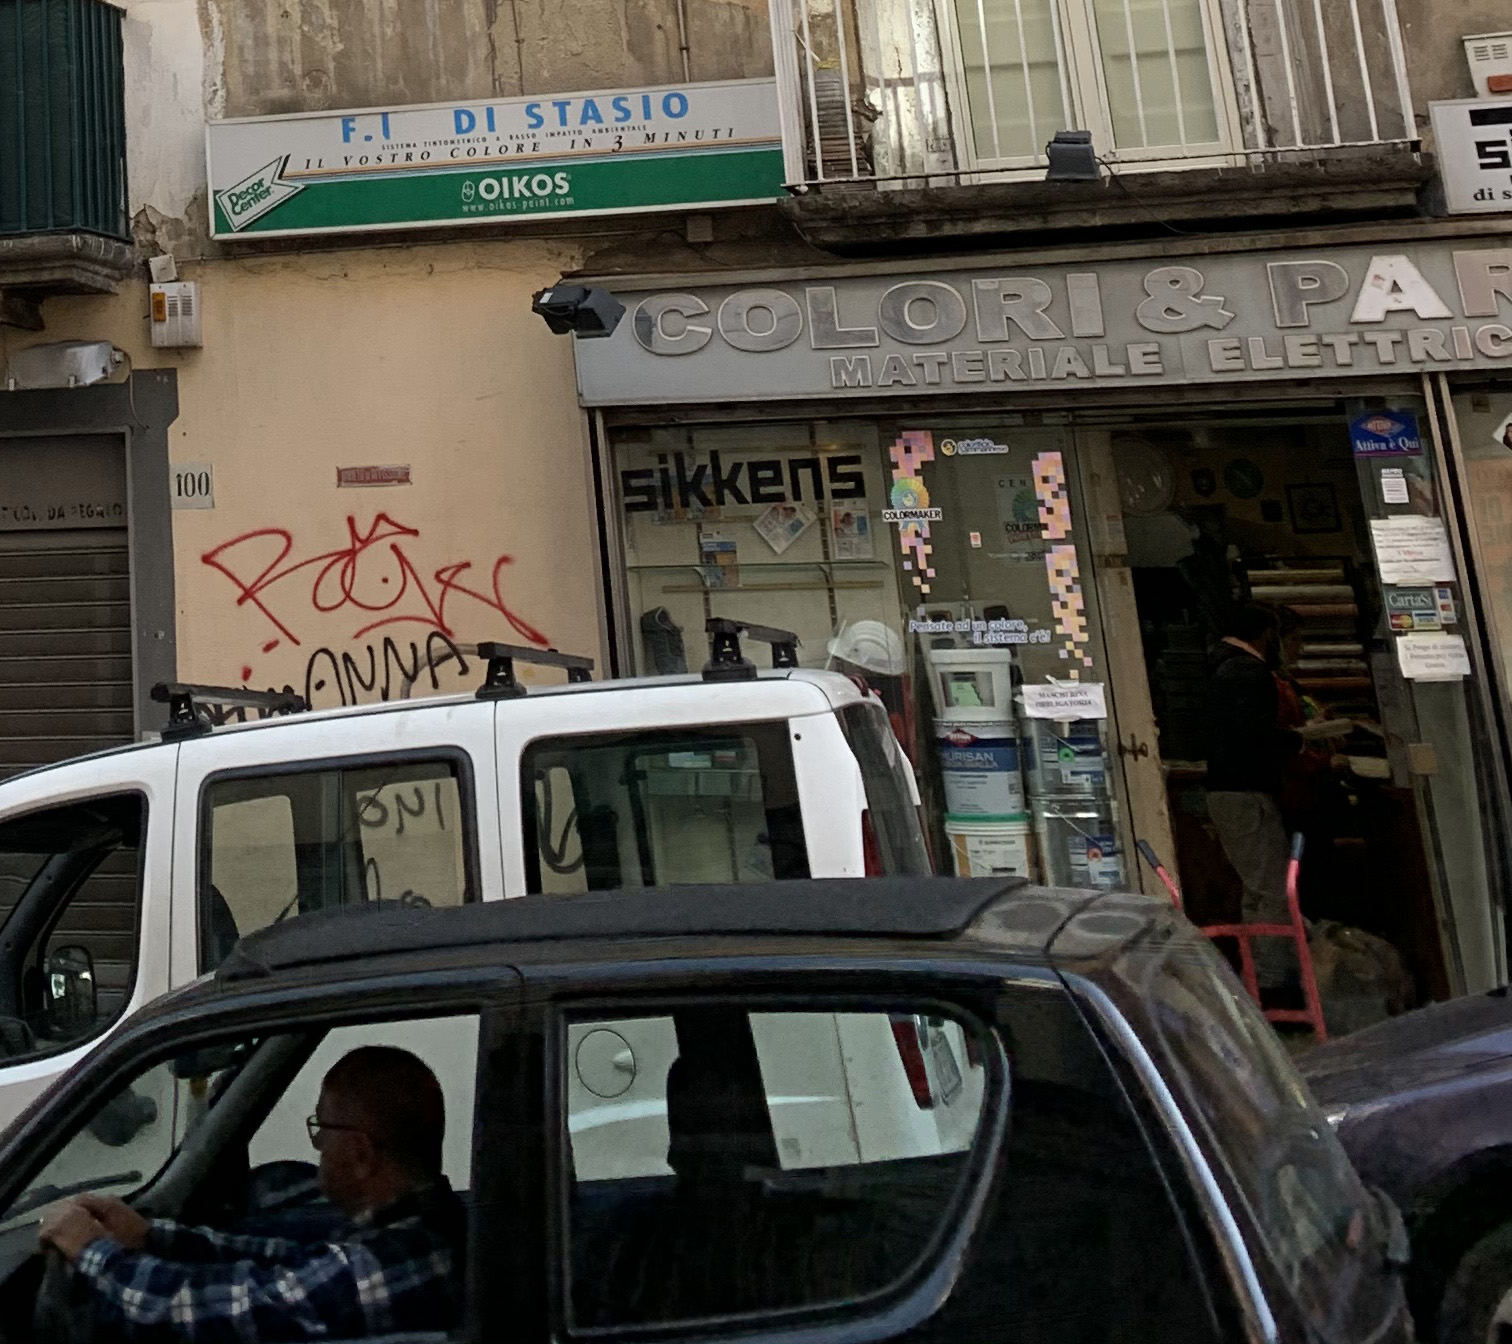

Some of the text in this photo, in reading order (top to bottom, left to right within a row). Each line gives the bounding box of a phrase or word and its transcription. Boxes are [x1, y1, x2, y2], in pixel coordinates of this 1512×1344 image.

[453, 106, 497, 136] DI
[524, 91, 689, 130] STASIO
[304, 126, 735, 170] IL VOSTRO COLORE IN 3 MINUTI
[228, 177, 265, 205] Decor
[232, 185, 272, 216] Center
[478, 172, 571, 201] OIKOS
[1473, 188, 1496, 201] di
[461, 195, 575, 213] www.oikos-paint.com
[632, 272, 1106, 357] COLORI
[1136, 265, 1236, 334] &
[829, 342, 1165, 389] MATERIALE
[175, 471, 211, 498] 100
[620, 449, 867, 513] sikkens
[883, 510, 942, 522] COLORMAKER
[909, 620, 953, 632] Pensate
[955, 619, 970, 631] ad
[972, 621, 987, 631] un
[984, 631, 1028, 644] sistema
[305, 630, 470, 712] ANNA
